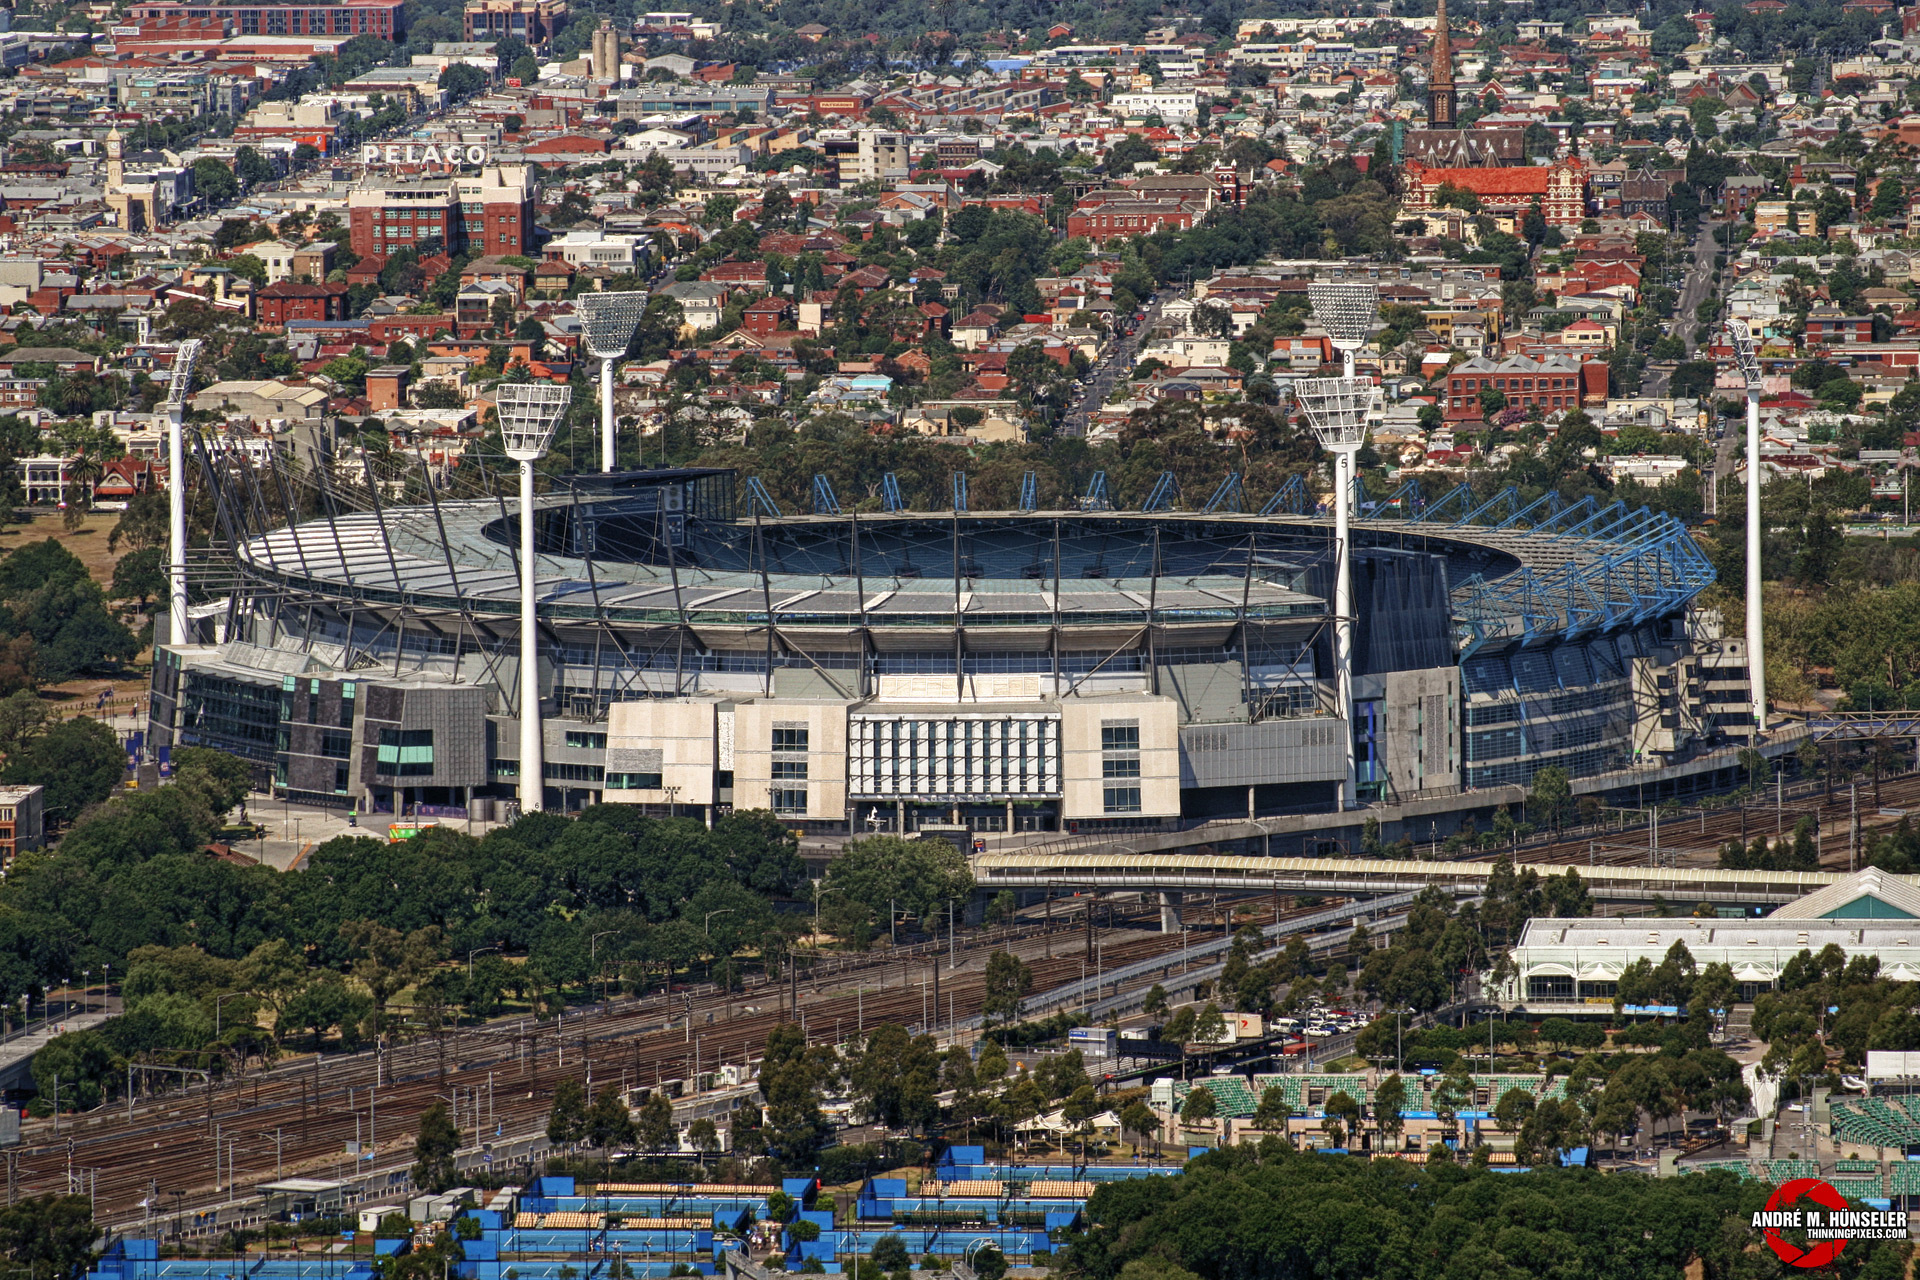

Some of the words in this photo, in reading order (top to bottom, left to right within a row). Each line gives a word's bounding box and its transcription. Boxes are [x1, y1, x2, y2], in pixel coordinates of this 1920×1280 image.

[363, 145, 485, 165] PELACO
[1344, 354, 1351, 364] 3
[606, 363, 612, 371] 2
[1341, 458, 1348, 468] 5
[520, 465, 526, 475] 6
